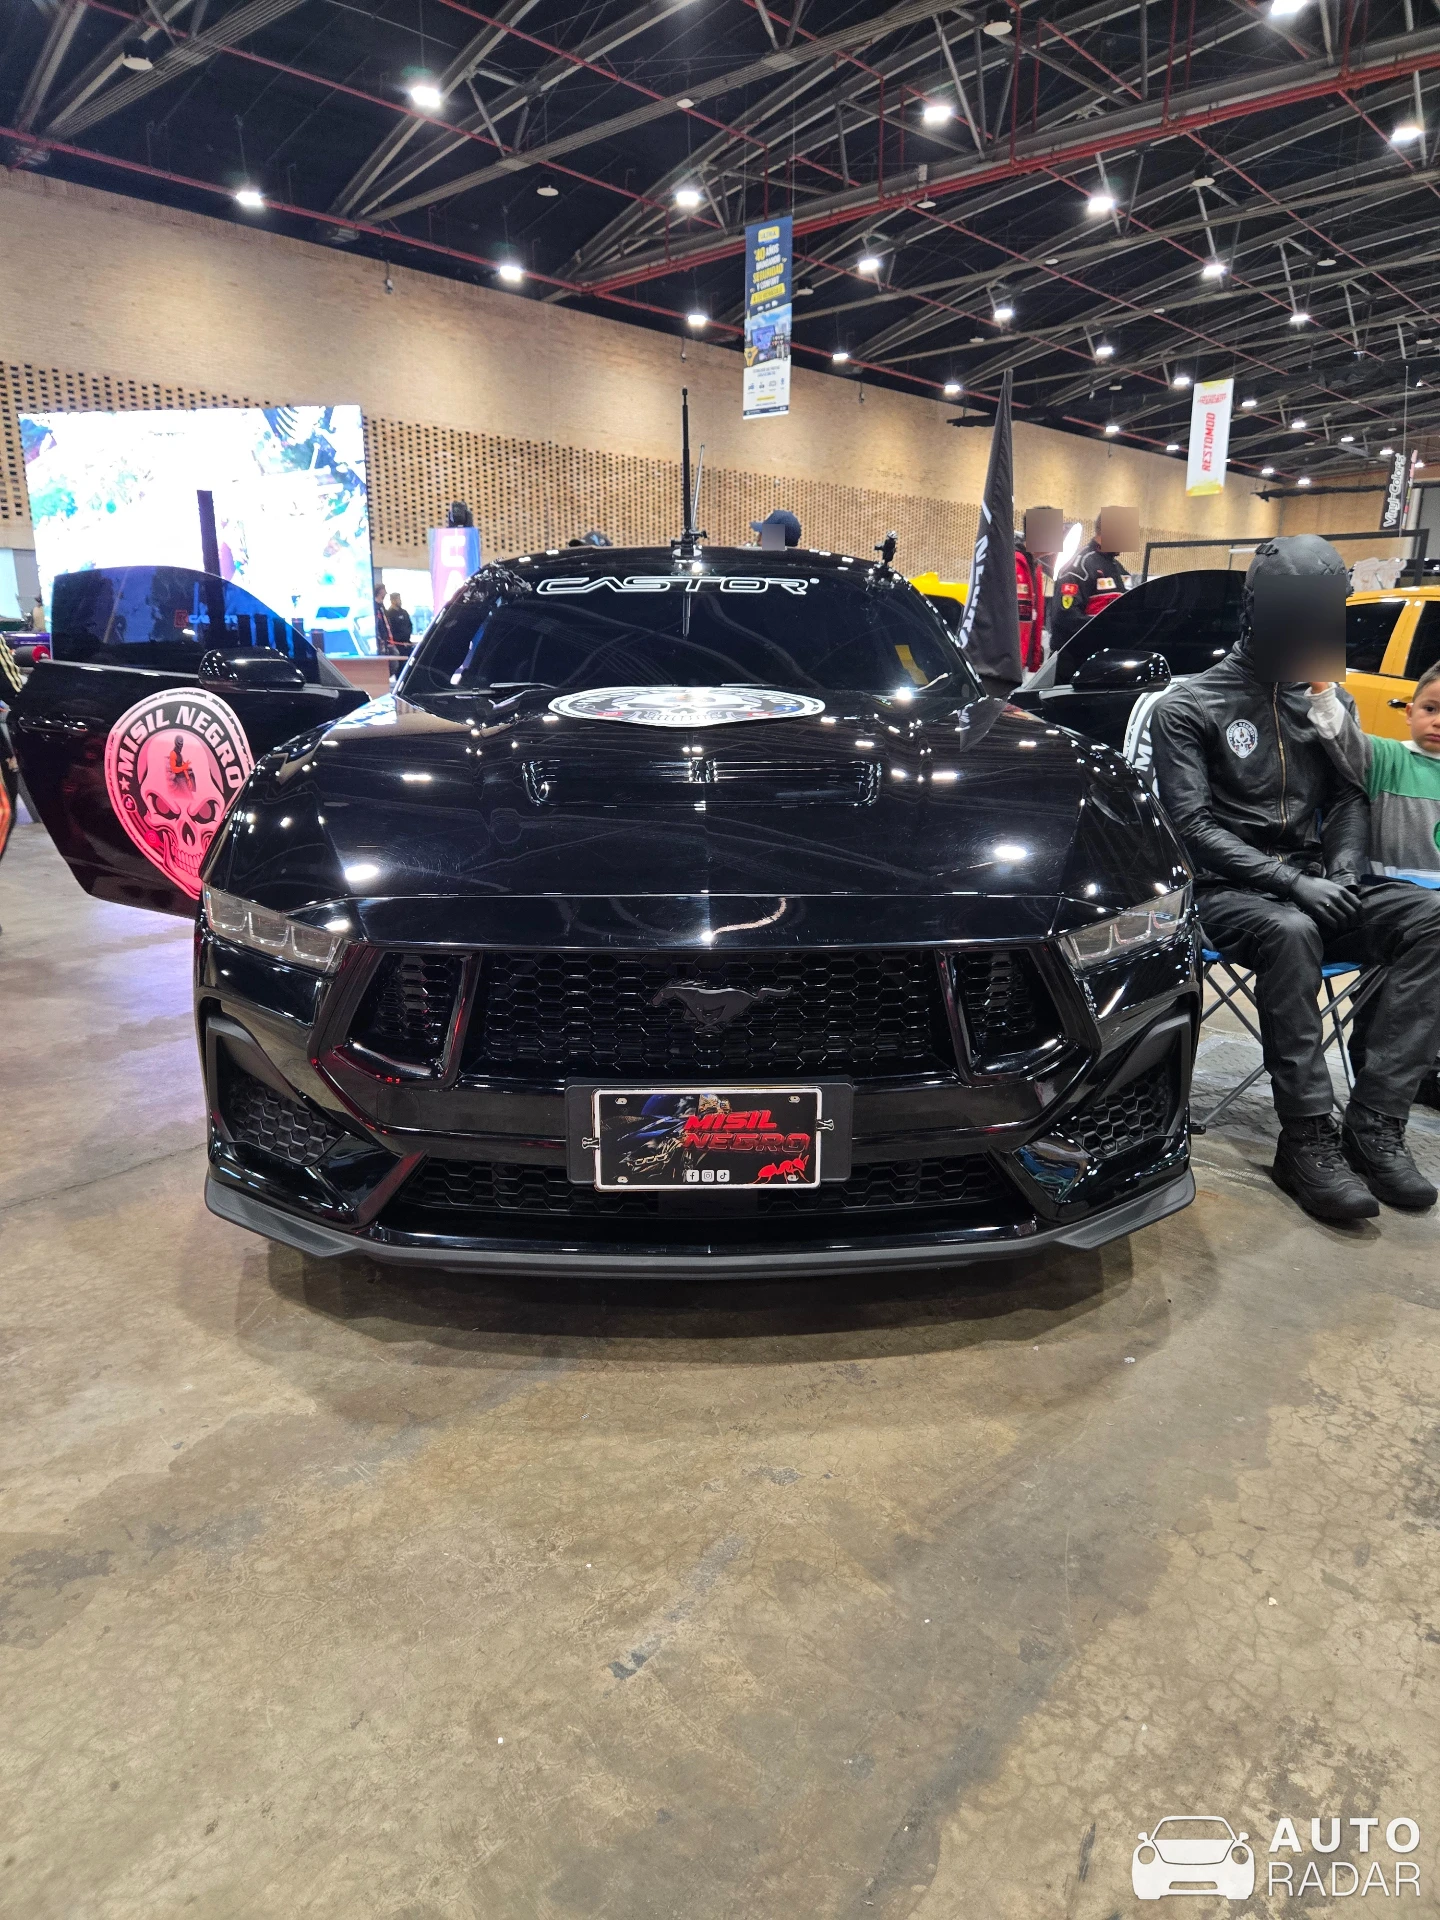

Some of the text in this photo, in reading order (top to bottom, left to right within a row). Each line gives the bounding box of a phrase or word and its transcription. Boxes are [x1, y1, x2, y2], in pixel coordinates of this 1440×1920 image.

[1202, 412, 1215, 472] RESTOMOD
[536, 576, 808, 595] CASTOR
[117, 708, 170, 778] MISIL
[175, 705, 244, 789] NEGRO
[683, 1109, 778, 1131] MISIL
[683, 1132, 811, 1153] NEGRO
